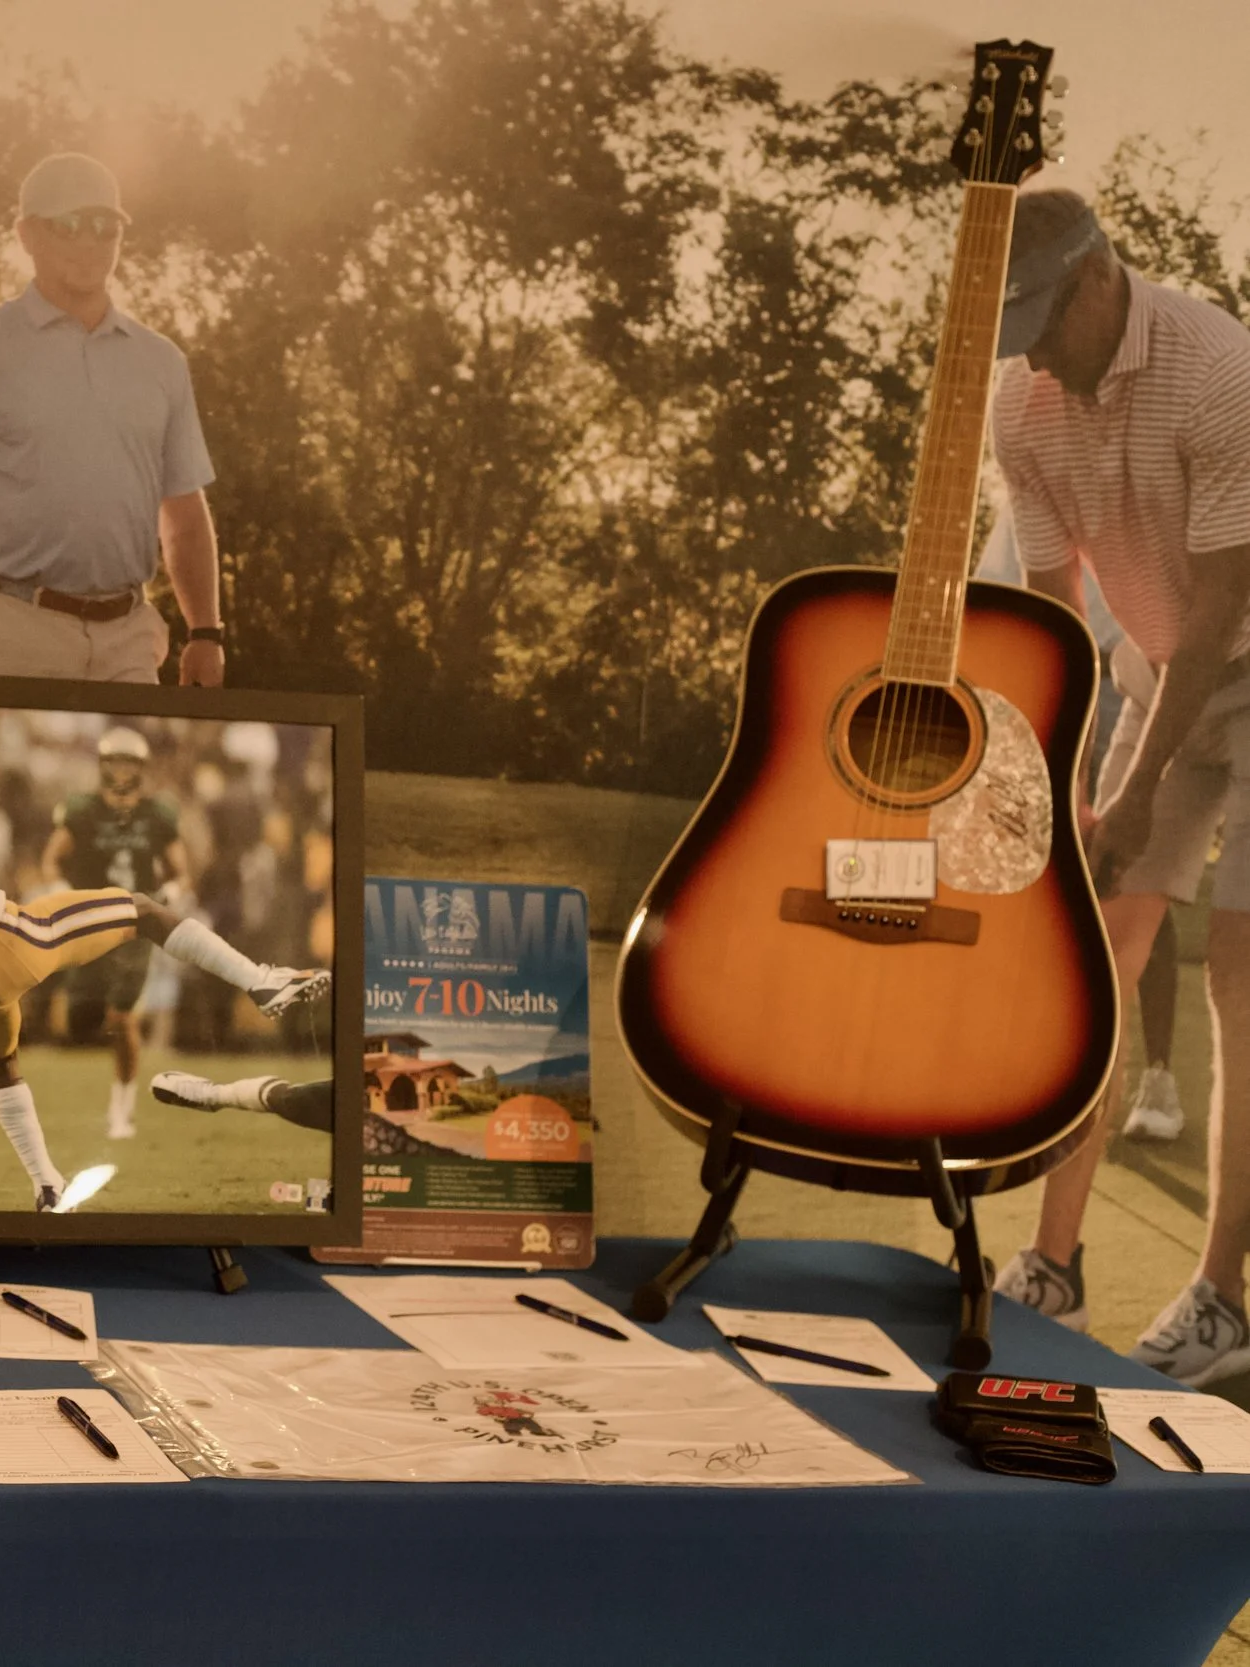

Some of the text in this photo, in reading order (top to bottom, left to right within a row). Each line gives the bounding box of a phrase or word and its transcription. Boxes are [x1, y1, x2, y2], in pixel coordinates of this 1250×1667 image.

[363, 882, 588, 955] ANAMA
[363, 975, 560, 1018] njoy 7-10 Nights
[493, 1119, 571, 1143] $4,350
[521, 1387, 598, 1414] OPEN
[977, 1377, 1076, 1403] UFC
[453, 1425, 620, 1454] PINEHURST
